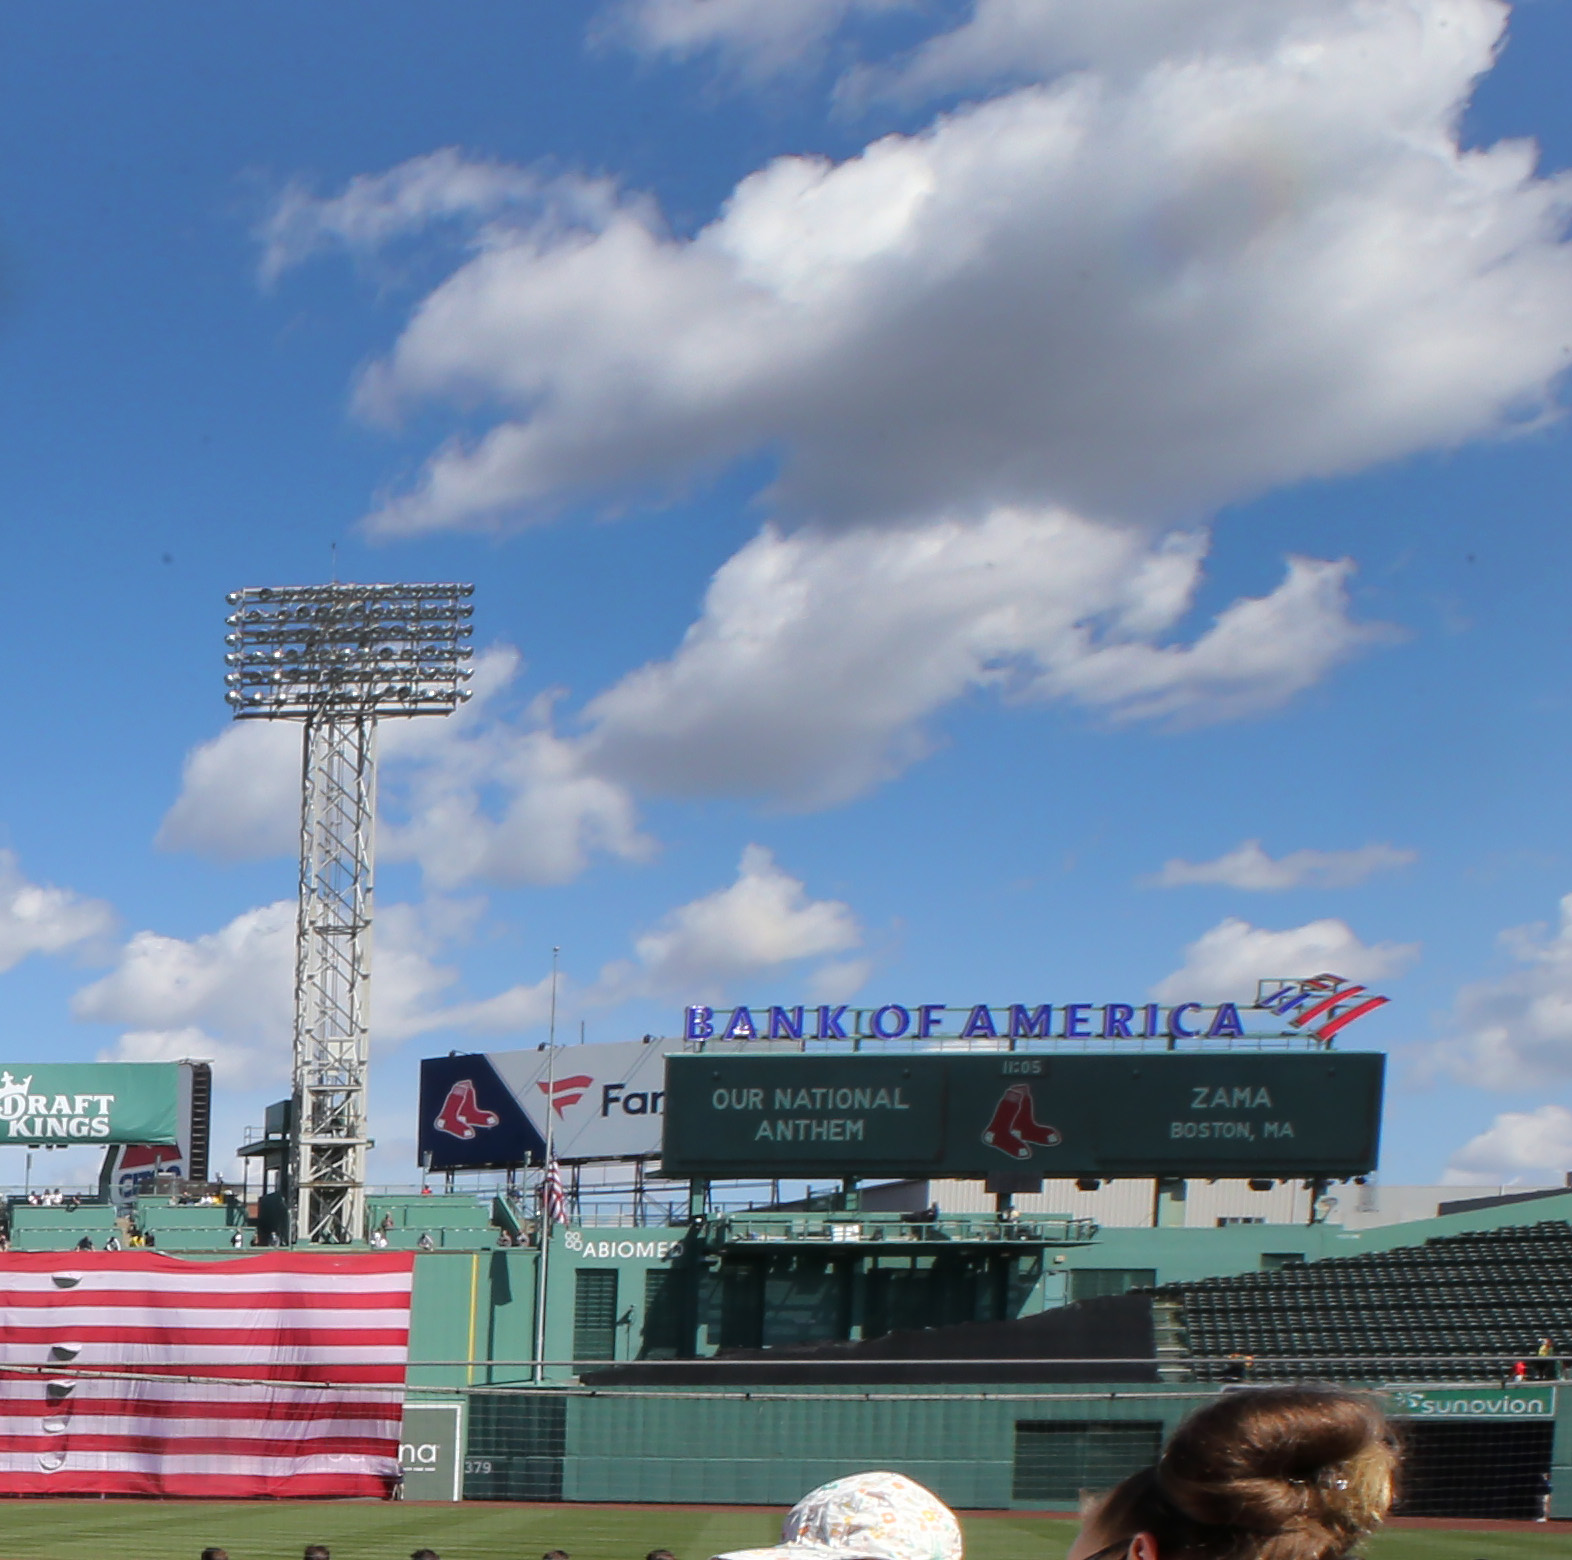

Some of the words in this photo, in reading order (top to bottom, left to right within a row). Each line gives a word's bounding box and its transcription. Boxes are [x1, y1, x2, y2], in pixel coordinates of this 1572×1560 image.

[684, 1004, 850, 1041] BANK
[869, 1003, 947, 1041] OF
[960, 1002, 1245, 1040] AMERICA
[712, 1088, 763, 1110] OUR
[774, 1087, 910, 1110] NATIONAL
[1191, 1087, 1273, 1109] ZAMA
[7, 1115, 111, 1138] KINGS
[754, 1119, 865, 1141] ANTHEM
[1170, 1121, 1255, 1142] BOSTON,
[1263, 1121, 1295, 1139] MA
[583, 1240, 684, 1258] ABIOMED
[1420, 1395, 1544, 1414] sunovion
[465, 1461, 493, 1474] 379
